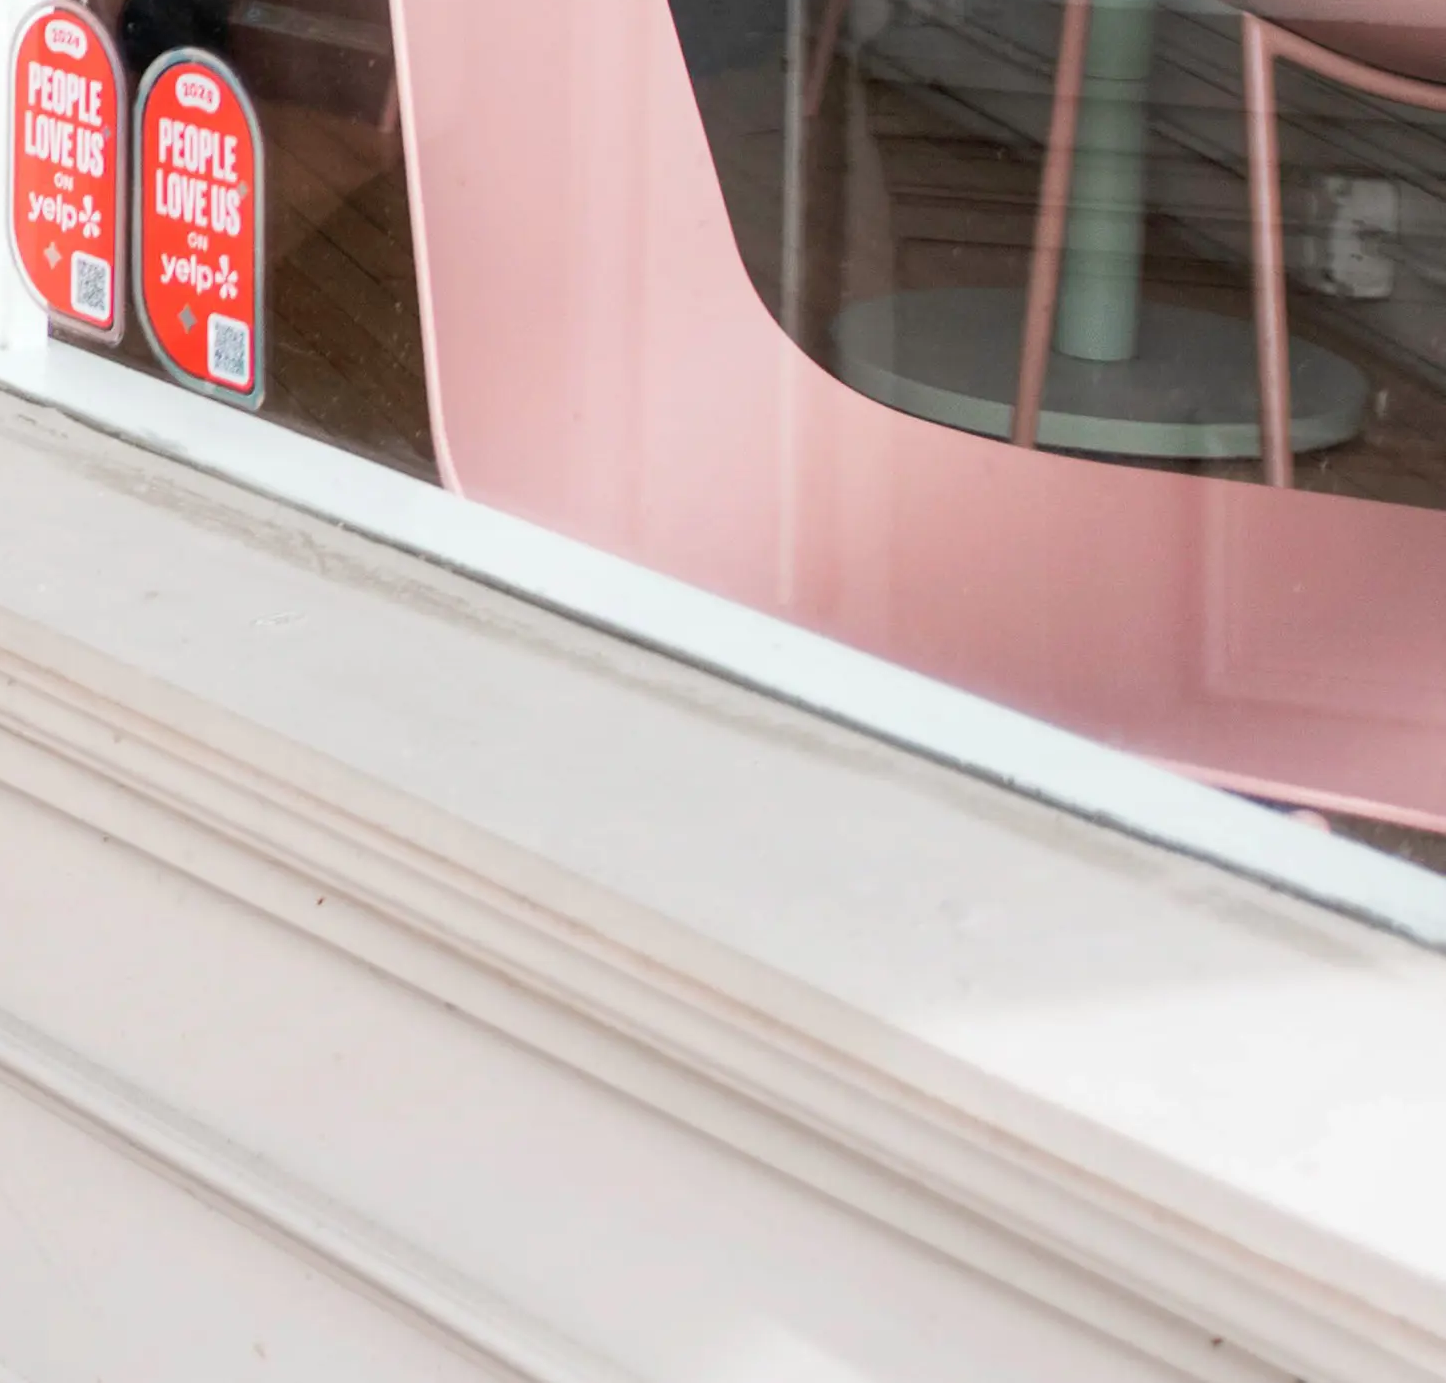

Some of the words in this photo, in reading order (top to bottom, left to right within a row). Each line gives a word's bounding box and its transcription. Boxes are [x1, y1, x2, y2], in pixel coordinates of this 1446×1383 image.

[28, 61, 103, 126] PEOPLE
[24, 110, 75, 169] LOVE
[76, 127, 105, 178] US
[158, 117, 238, 182] PEOPLE
[54, 171, 74, 192] ON
[155, 168, 208, 228] LOVE
[211, 185, 242, 237] US
[28, 191, 77, 232] yelp
[187, 232, 209, 252] ON
[160, 252, 213, 295] yelp
